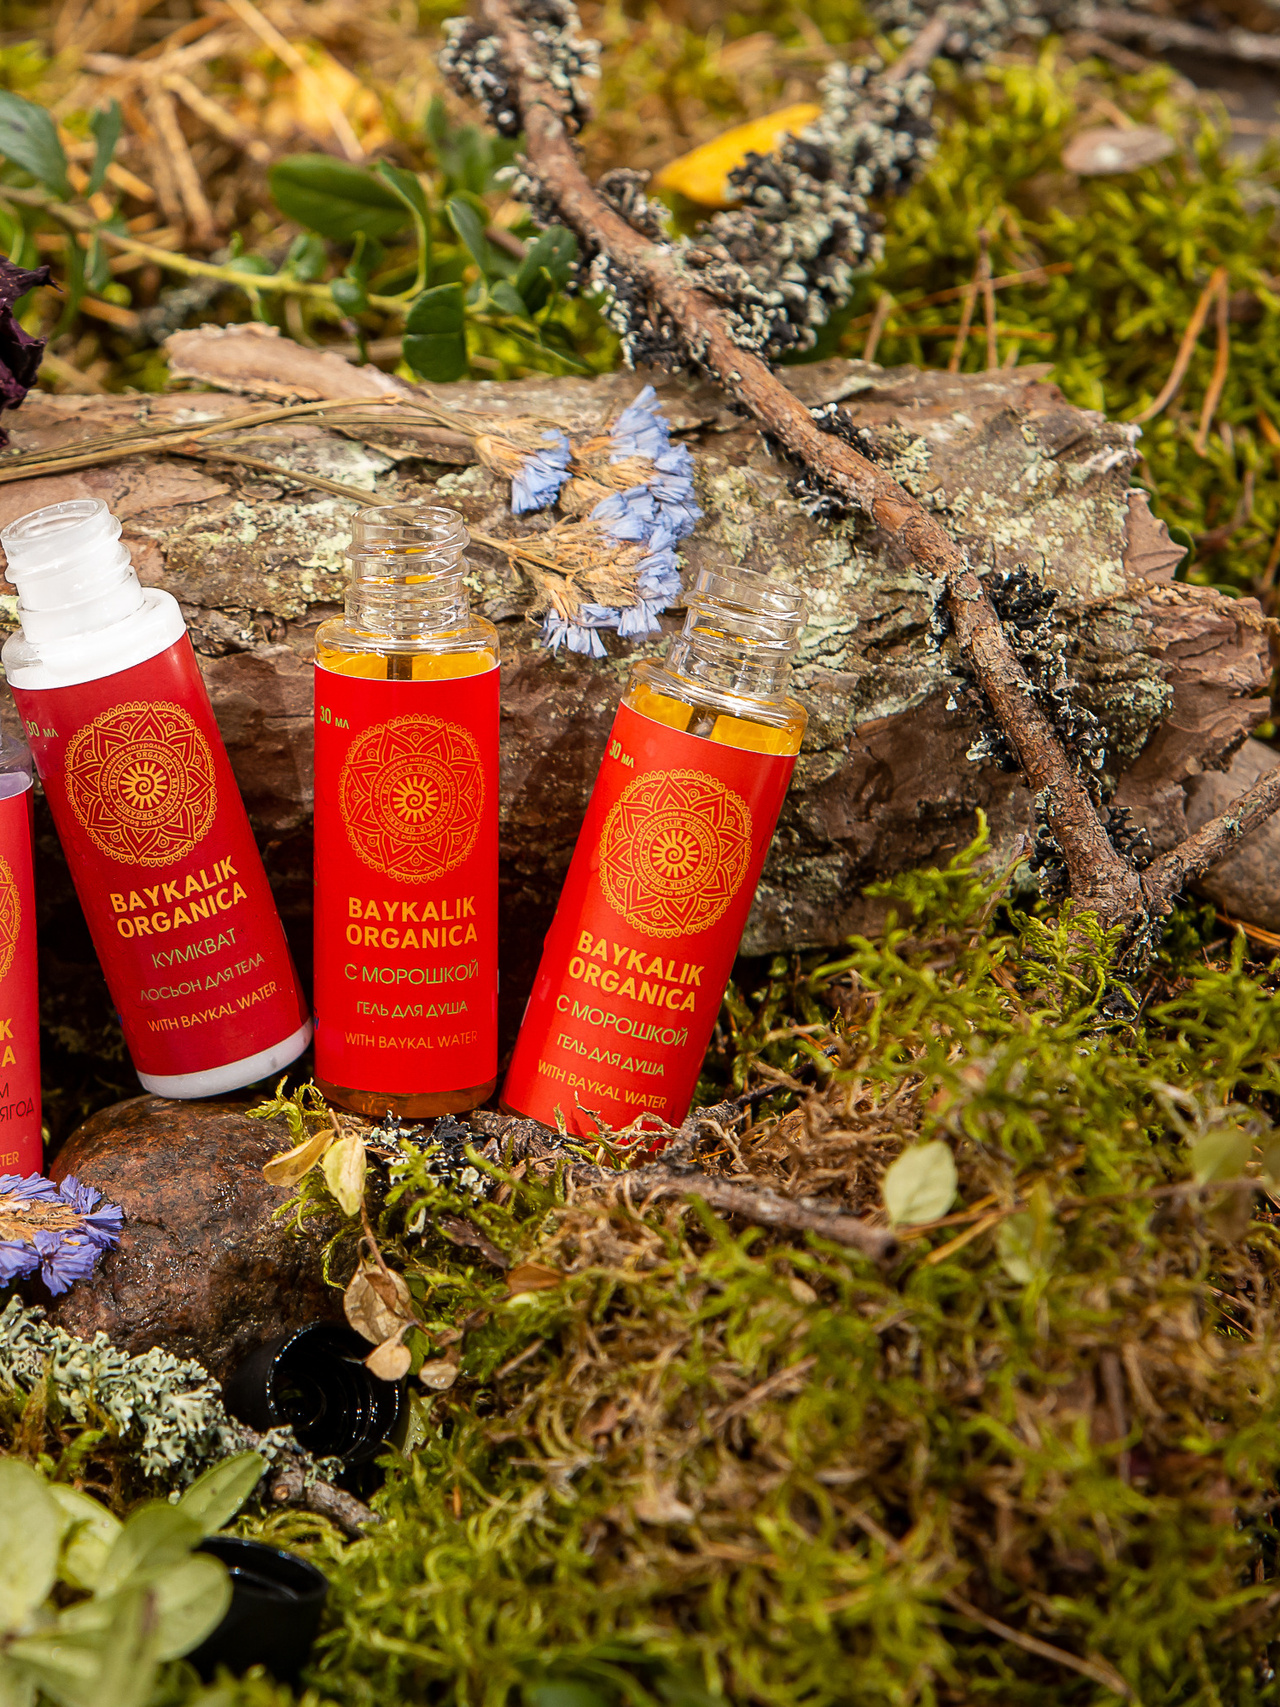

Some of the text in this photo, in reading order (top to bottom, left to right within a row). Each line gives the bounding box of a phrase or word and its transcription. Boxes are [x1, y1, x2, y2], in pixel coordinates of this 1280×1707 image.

[26, 720, 59, 737] 30 мл
[320, 705, 349, 729] 30 мл
[609, 739, 634, 768] 30 мл
[110, 855, 238, 913] BAYKALIK
[117, 882, 247, 938] ORGANICA
[348, 896, 476, 922] BAYKALIK
[151, 928, 236, 968] КУМКВАТ
[346, 923, 477, 949] ORGANICA
[140, 953, 265, 1001] ЛОСЬОН ДЛЯ ТЕЛА
[345, 959, 478, 984] С МОРОШКОЙ
[577, 930, 704, 986] BAYKALIK
[569, 957, 696, 1012] ORGANICA
[147, 982, 277, 1032] WITH BAYKAL WATER
[357, 1001, 468, 1018] ГЕЛЬ ДЛЯ ДУША
[556, 995, 688, 1047] С МОРОШКОЙ
[345, 1031, 478, 1049] WITH BAYKAL WATER
[557, 1034, 664, 1076] ГЕЛЬ ДЛЯ ДУША
[538, 1059, 667, 1109] WITH BAYKAL WATER
[0, 1098, 34, 1122] ЯГОД
